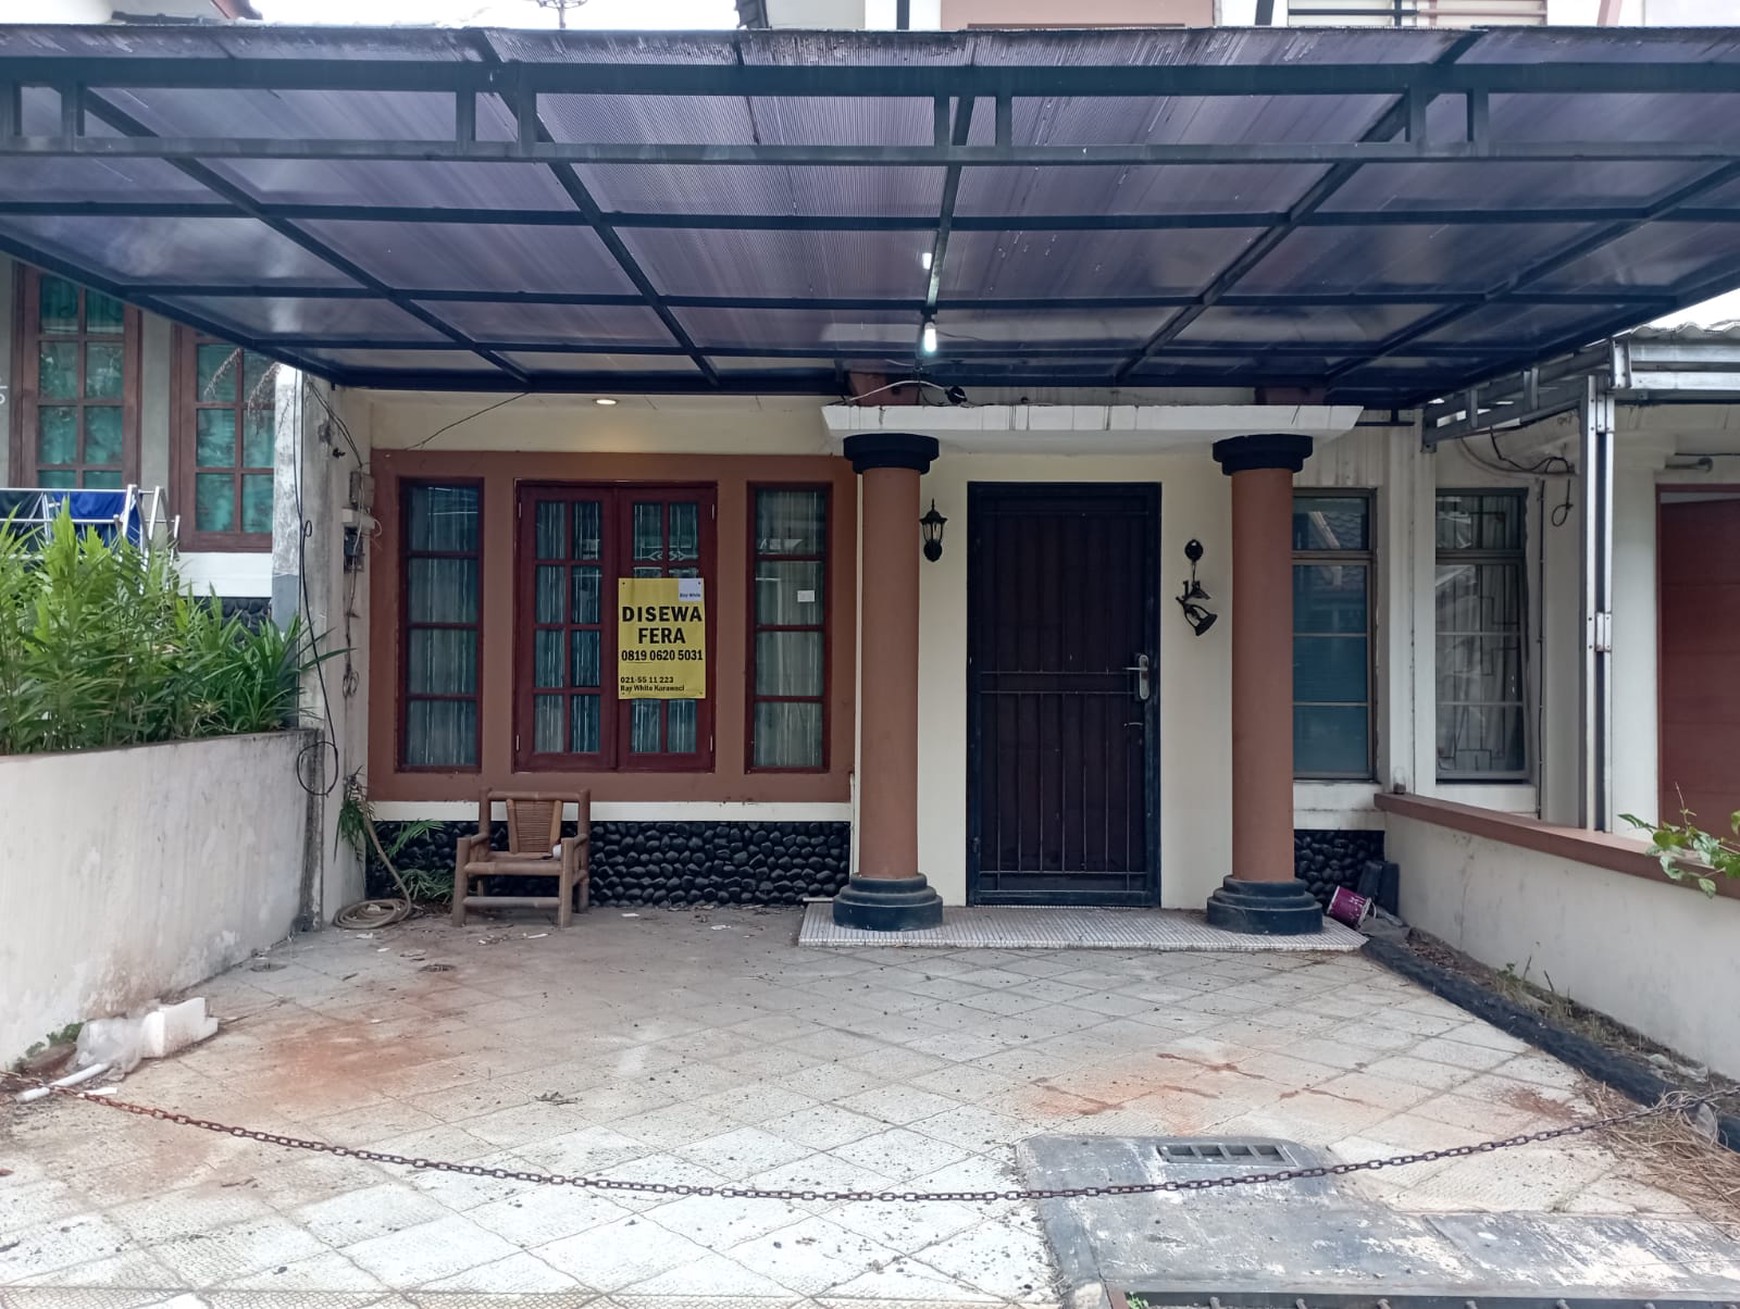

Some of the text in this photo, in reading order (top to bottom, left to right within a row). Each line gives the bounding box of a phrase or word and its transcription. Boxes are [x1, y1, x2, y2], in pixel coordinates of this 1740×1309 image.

[622, 606, 702, 622] DISEWA
[638, 627, 686, 644] FERA
[621, 649, 703, 661] 0819 0620 5031
[649, 676, 658, 684] 11
[659, 676, 674, 684] 223
[620, 685, 632, 693] Ray
[633, 684, 653, 692] White
